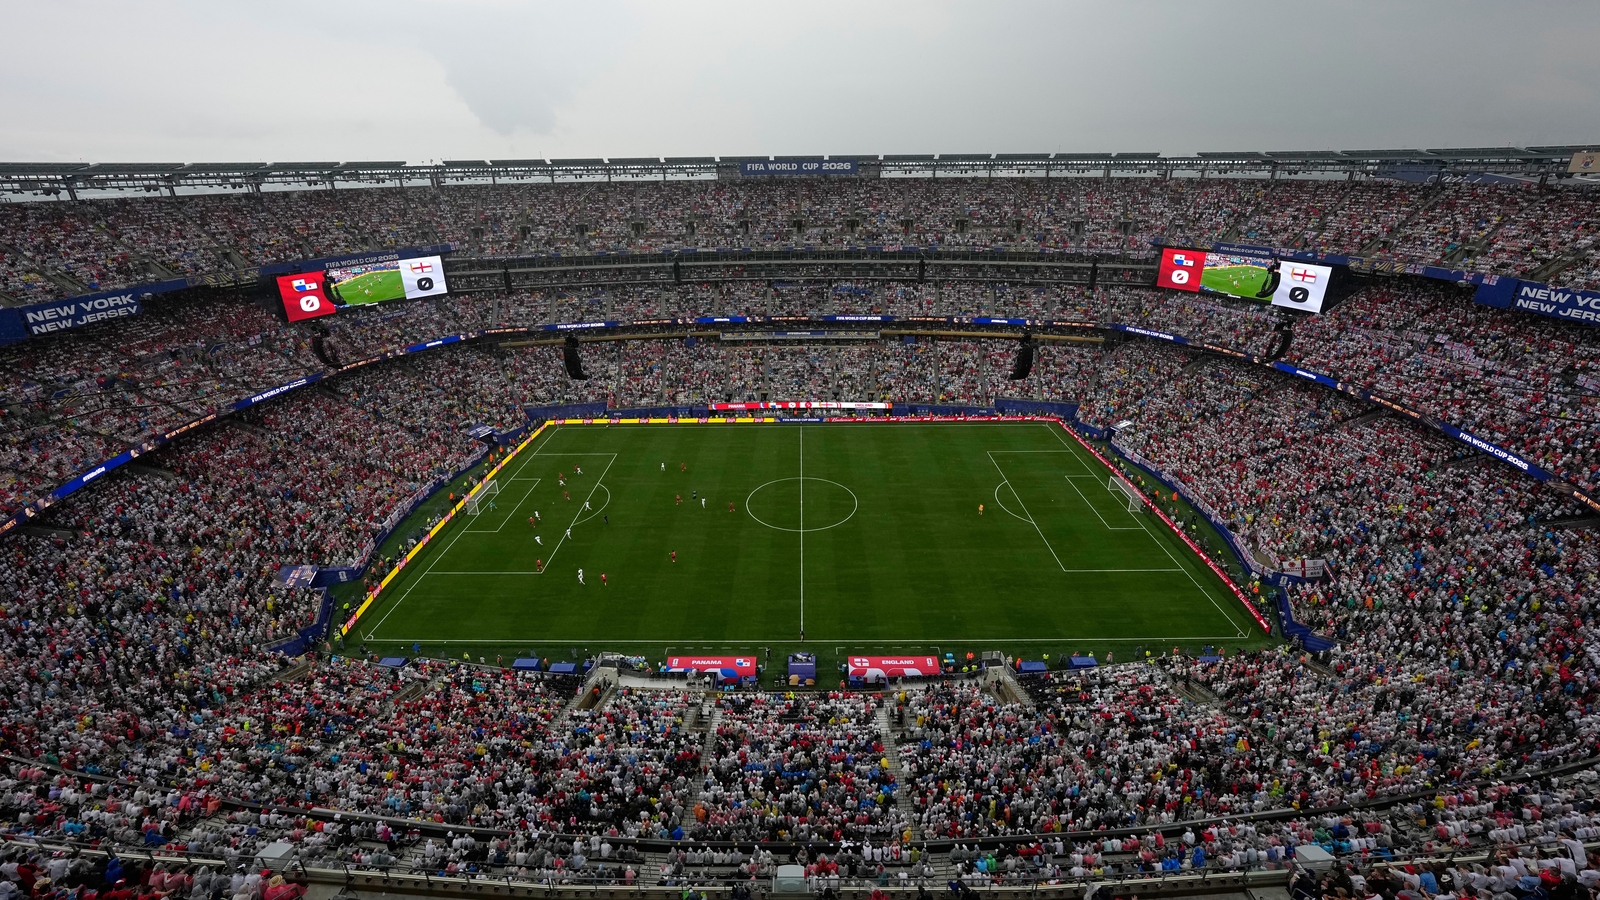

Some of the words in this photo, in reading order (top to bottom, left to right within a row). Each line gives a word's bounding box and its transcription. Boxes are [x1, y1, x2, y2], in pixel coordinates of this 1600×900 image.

[747, 163, 765, 171] FIFA
[768, 163, 798, 171] WORLD
[802, 162, 819, 170] CUP
[822, 162, 852, 170] 2026
[341, 258, 364, 268] WORLD
[378, 254, 400, 262] 2026
[1520, 286, 1572, 304] NEW
[26, 304, 76, 323] NEW
[80, 294, 136, 315] YORK
[1516, 298, 1556, 313] NEW
[32, 319, 72, 335] NEW
[76, 306, 138, 325] JERSEY
[251, 394, 264, 403] FIFA
[262, 388, 280, 399] WORLD
[1459, 432, 1472, 443] FIFA
[1472, 438, 1495, 453] WORLD
[1494, 449, 1508, 458] CUP
[1507, 455, 1529, 470] 2026
[1207, 560, 1229, 583] Budweiser
[1237, 593, 1258, 618] Budweiser
